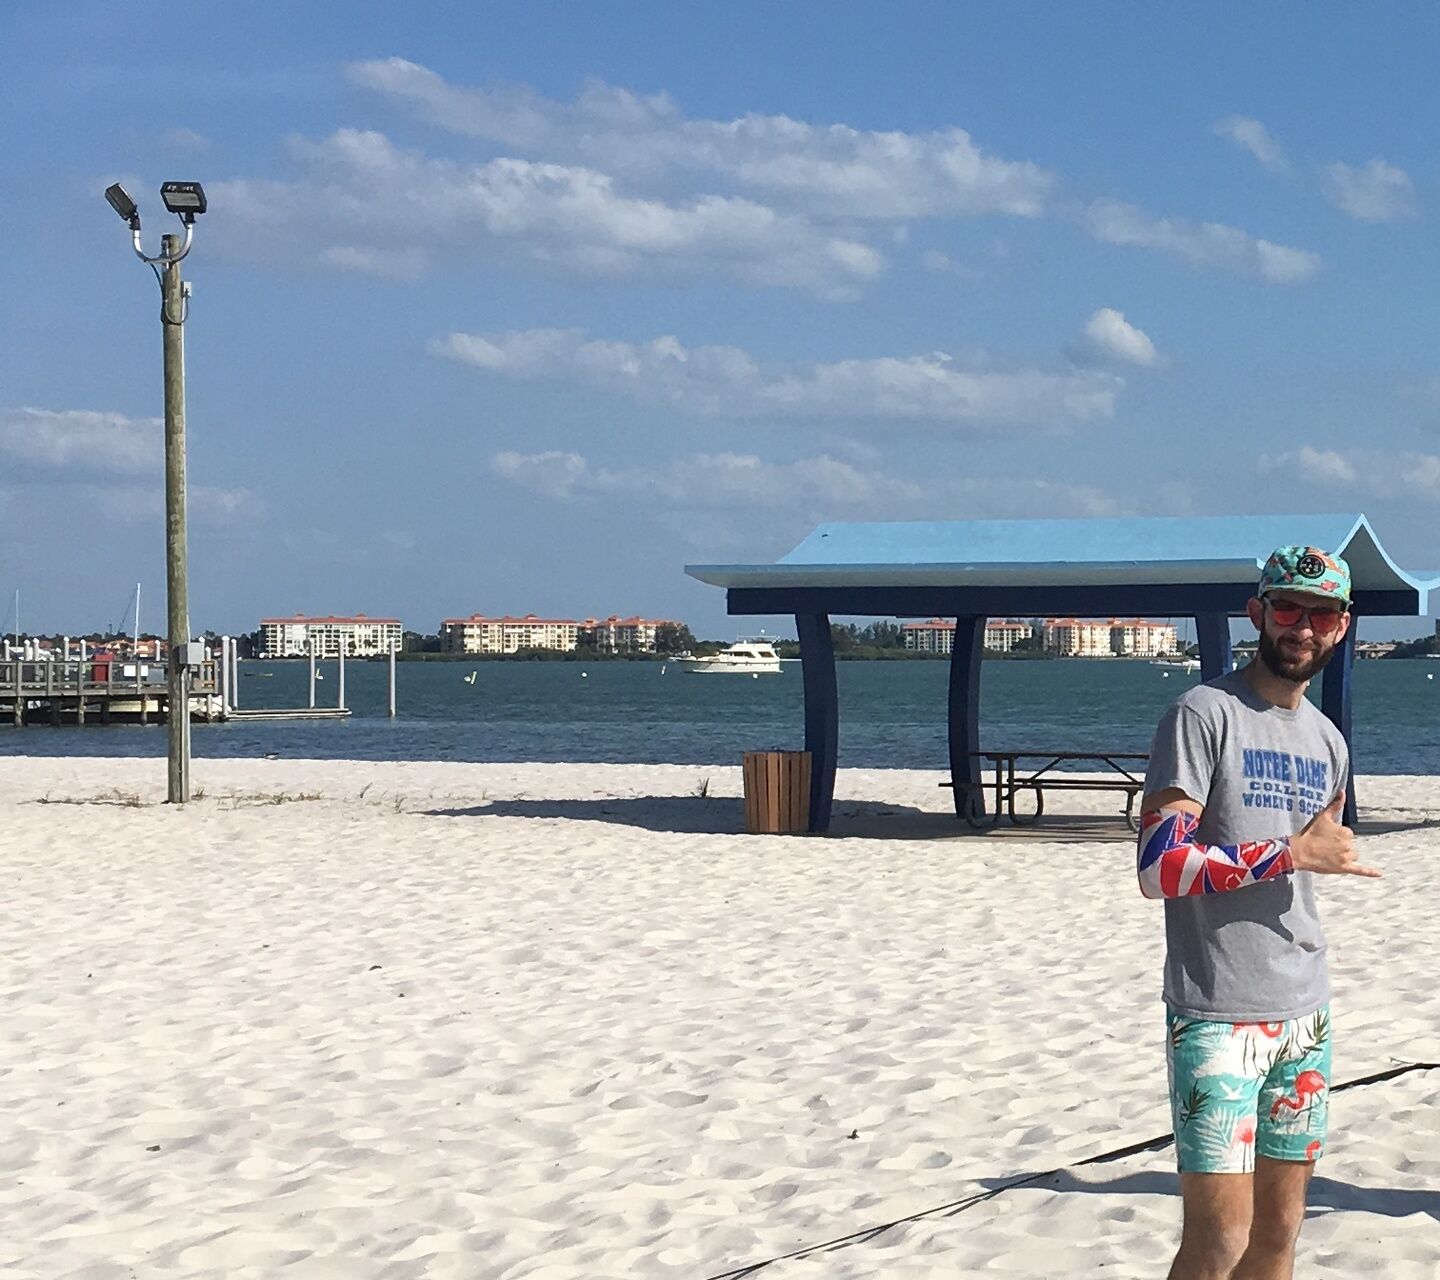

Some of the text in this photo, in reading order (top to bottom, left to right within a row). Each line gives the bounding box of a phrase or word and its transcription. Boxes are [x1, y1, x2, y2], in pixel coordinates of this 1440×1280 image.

[1242, 749, 1328, 791] NOTRE DAME
[1250, 781, 1324, 802] COLLEGE
